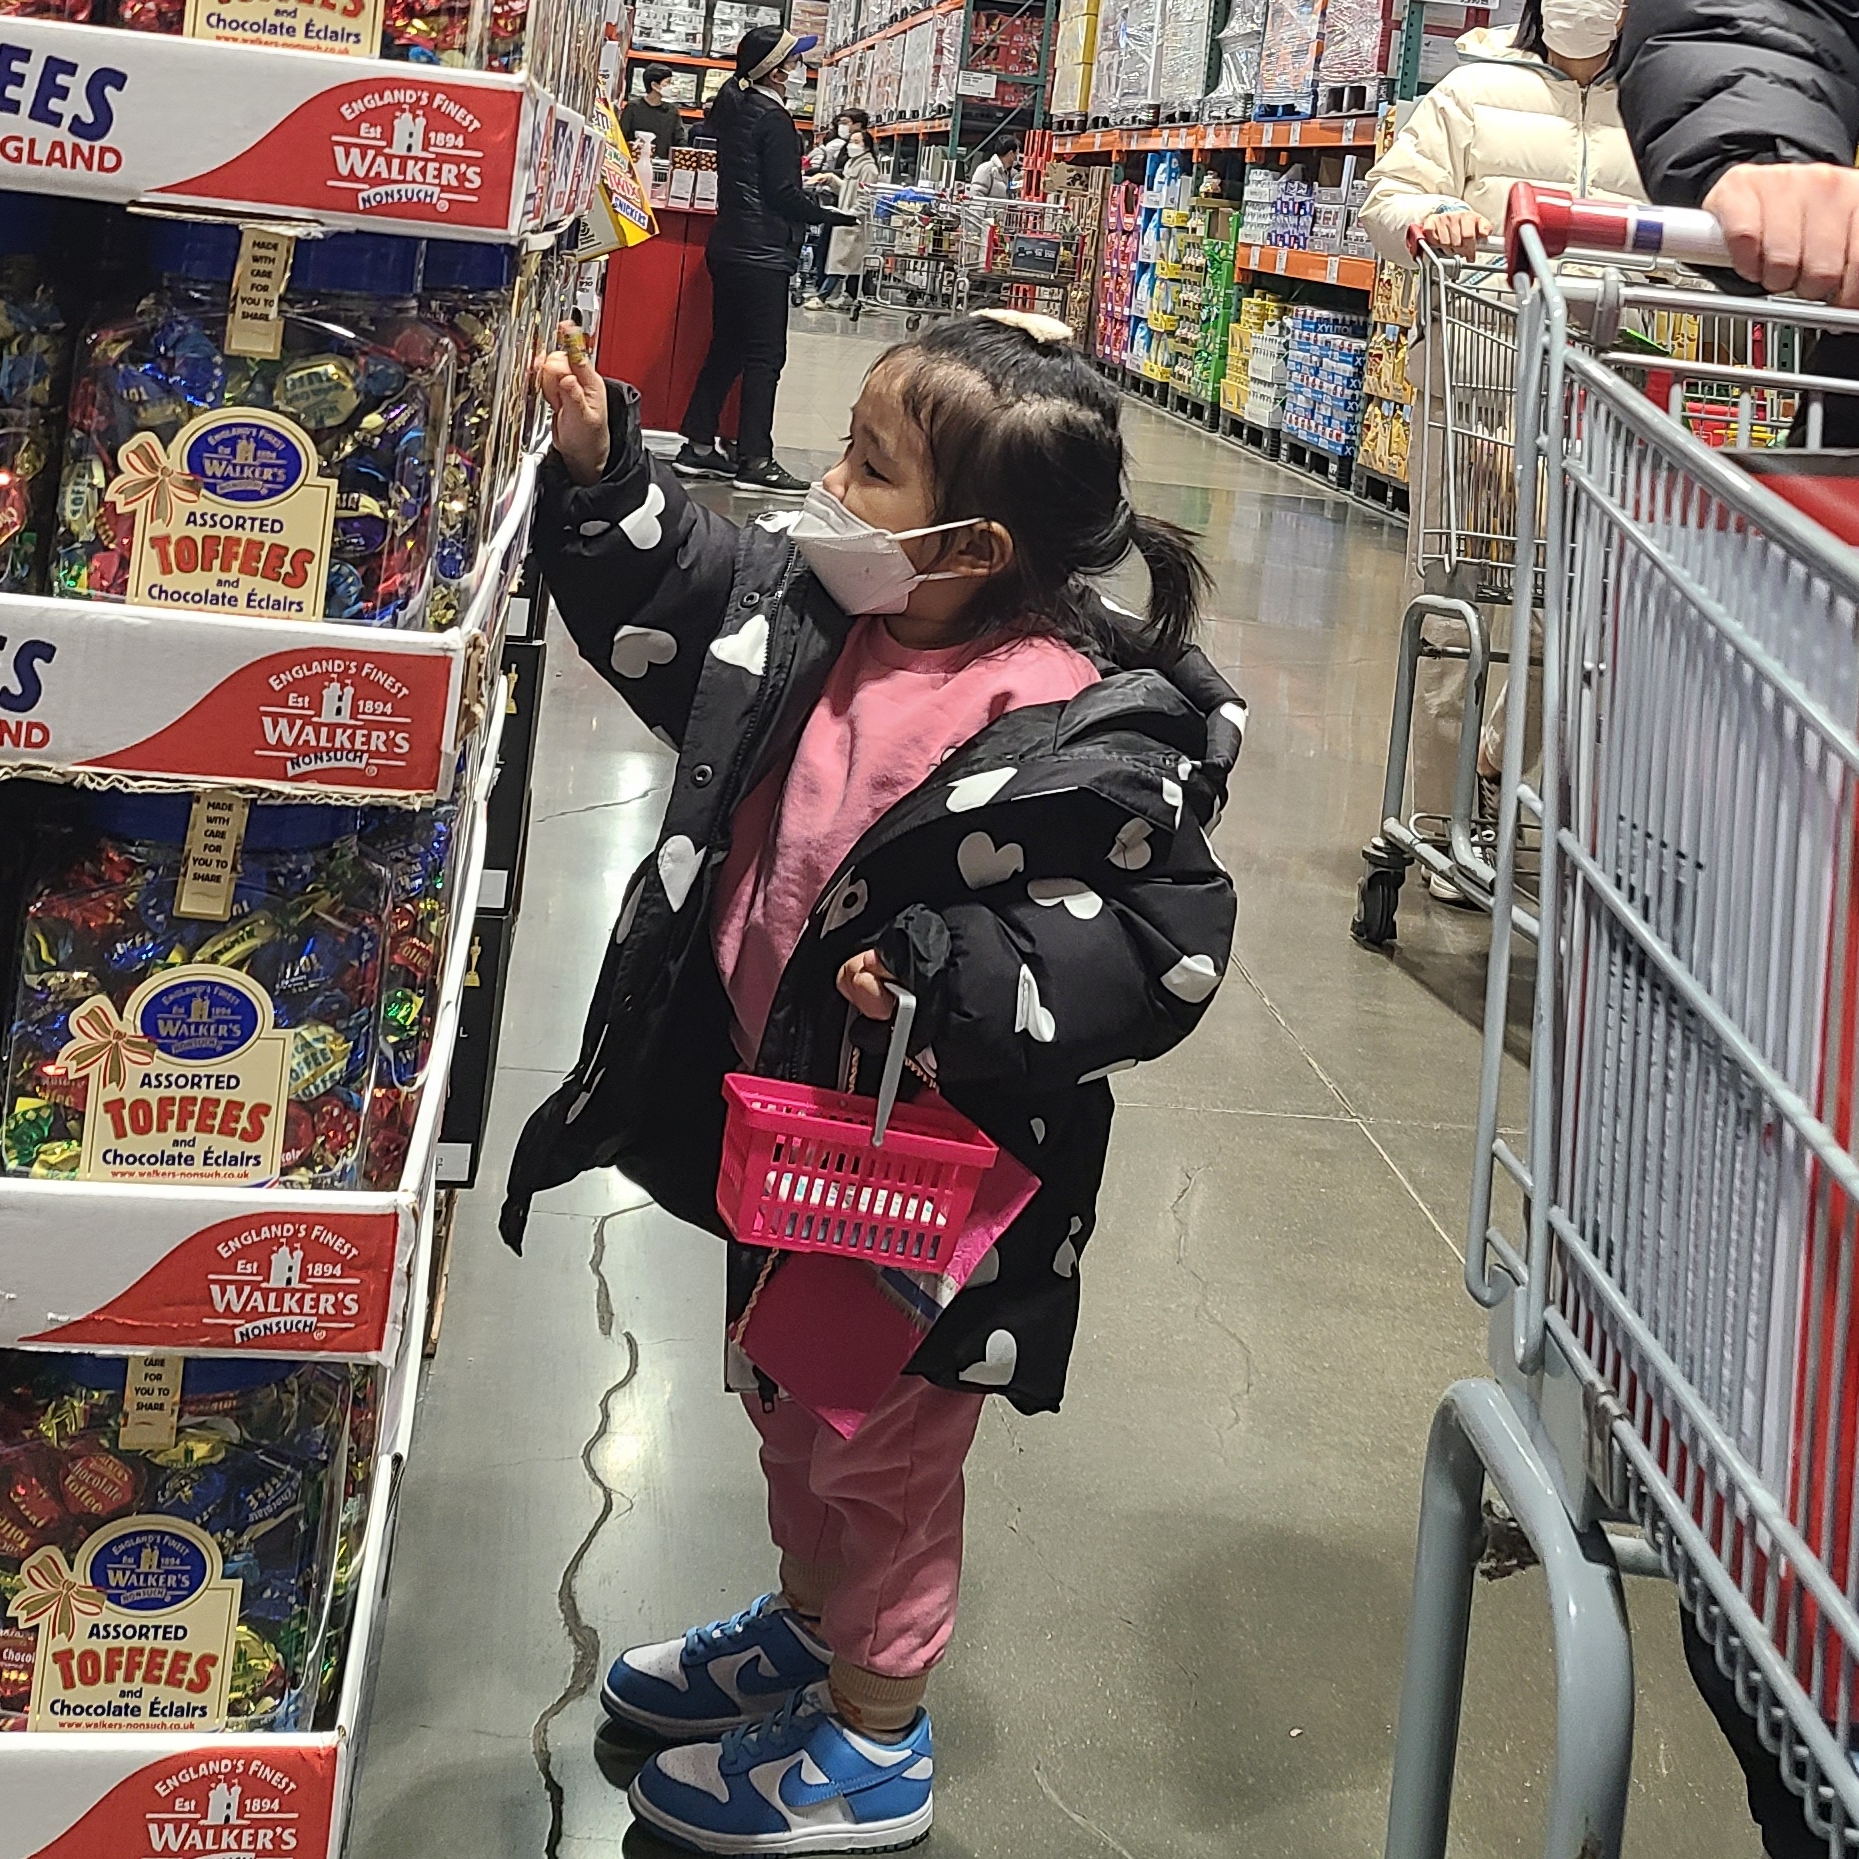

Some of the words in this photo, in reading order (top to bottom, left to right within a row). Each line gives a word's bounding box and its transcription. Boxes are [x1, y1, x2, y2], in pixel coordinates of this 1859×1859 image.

[274, 7, 298, 19] and
[206, 12, 296, 38] Chocolate
[304, 18, 361, 44] Éclairs
[339, 89, 430, 121] ENGLAND'S
[432, 92, 481, 133] FINEST
[360, 122, 382, 139] Est
[428, 131, 464, 148] 1894
[333, 145, 482, 189] WALKER'S
[361, 188, 435, 209] NONSUCH
[613, 196, 647, 227] SNICKERS
[252, 240, 279, 251] MADE
[252, 255, 276, 265] WITH
[250, 268, 273, 279] CARE
[250, 283, 270, 293] FOR
[240, 295, 261, 306] YOU
[264, 298, 275, 308] TO
[241, 311, 270, 320] SHARE
[203, 459, 287, 482] WALKER'S
[185, 511, 284, 534] ASSORTED
[149, 534, 316, 590] TOFFEES
[216, 577, 240, 590] and
[148, 584, 239, 608] Chocolate
[246, 588, 304, 613] Éclairs
[268, 659, 358, 692] ENGLAND'S
[361, 662, 410, 699] FINEST
[288, 692, 310, 708] Est
[357, 699, 393, 715] 1894
[261, 716, 411, 754] WALKER'S
[290, 750, 364, 771] NONSUCH
[206, 801, 235, 812] MADE
[206, 815, 231, 826] WITH
[203, 829, 227, 840] CARE
[203, 843, 222, 854] FOR
[192, 856, 213, 867] YOU
[215, 859, 229, 869] TO
[192, 872, 222, 883] SHARE
[157, 1019, 242, 1037] WALKER'S
[140, 1073, 241, 1090] ASSORTED
[103, 1095, 272, 1143] TOFFEES
[172, 1136, 196, 1148] and
[102, 1149, 195, 1167] Chocolate
[202, 1145, 262, 1167] Éclairs
[111, 1169, 250, 1180] www.walkers-nonsuch.co.uk
[216, 1223, 308, 1259] ENGLAND'S
[311, 1225, 360, 1260] FINEST
[236, 1259, 259, 1274] Est
[306, 1262, 342, 1277] 1894
[209, 1284, 360, 1316] WALKER'S
[239, 1319, 315, 1343] NONSUCH
[143, 1357, 165, 1367] CARE
[144, 1372, 163, 1382] FOR
[134, 1386, 154, 1396] YOU
[157, 1387, 170, 1396] TO
[136, 1402, 165, 1411] SHARE
[111, 1534, 161, 1556] ENGLAND'S
[107, 1569, 191, 1587] WALKER'S
[87, 1623, 188, 1641] ASSORTED
[51, 1646, 220, 1695] TOFFEES
[119, 1687, 143, 1699] and
[50, 1699, 142, 1718] Chocolate
[149, 1697, 208, 1718] Éclairs
[58, 1720, 196, 1731] www.walkers-nonsuch.co.uk
[154, 1758, 245, 1798] ENGLAND'S
[248, 1759, 297, 1795] FINEST
[174, 1797, 196, 1812] Est
[244, 1798, 280, 1812] 1894
[147, 1823, 298, 1852] WALKER'S
